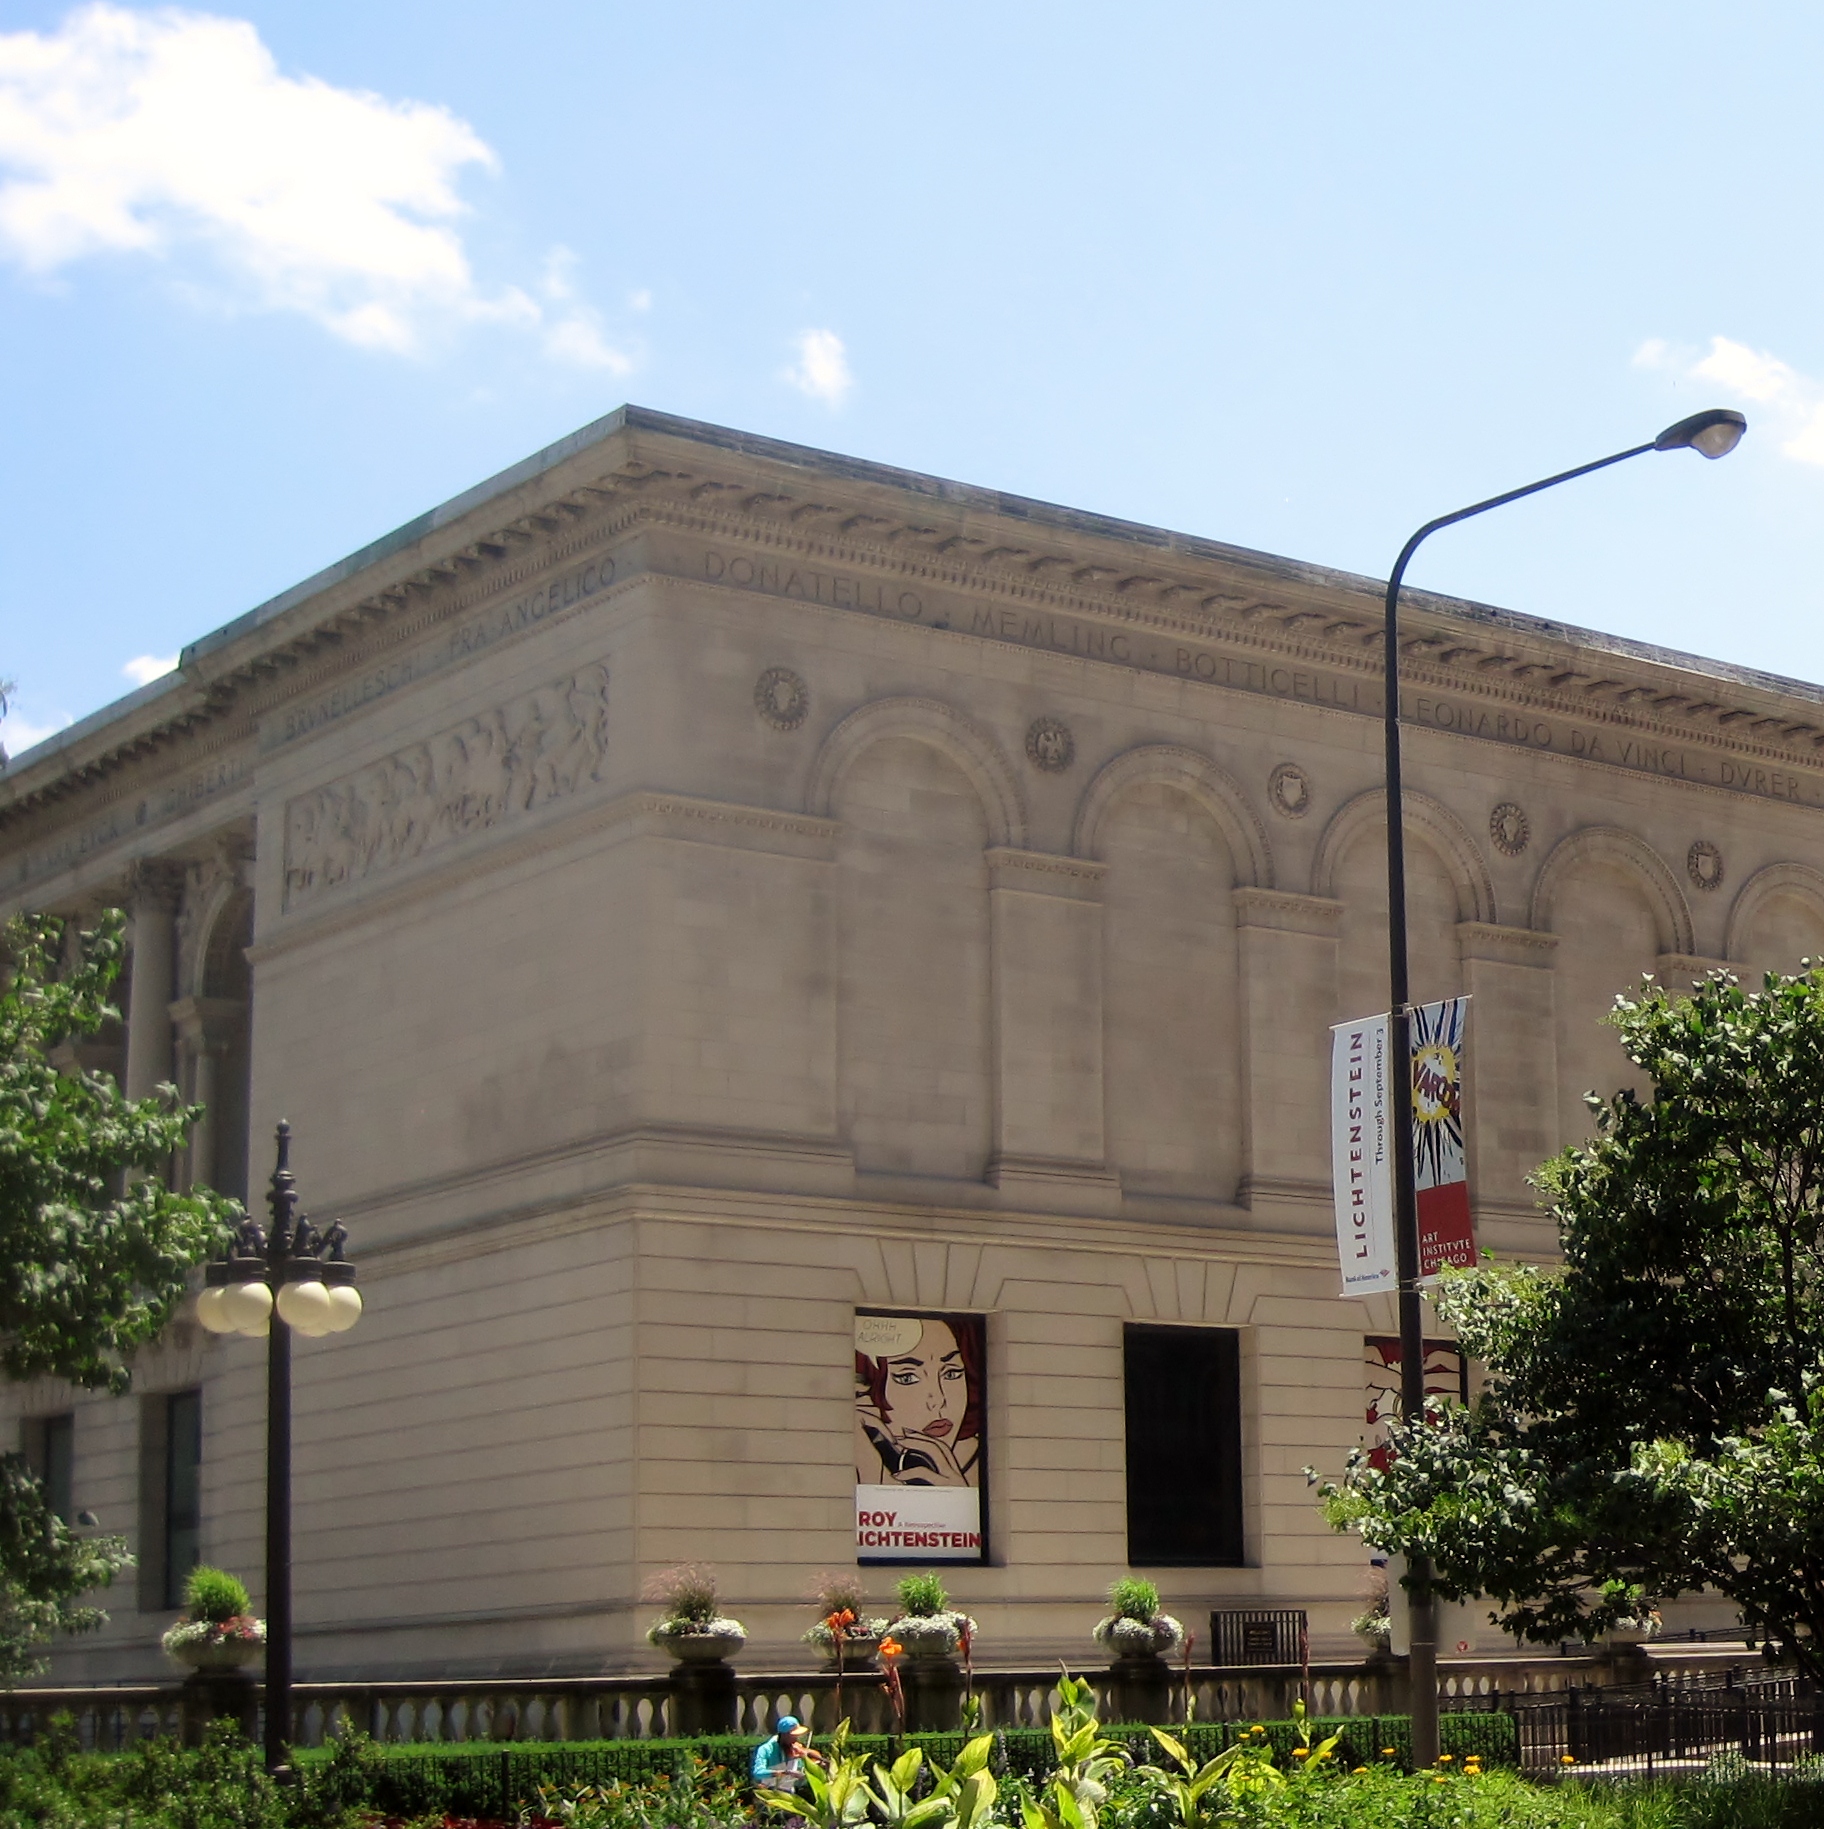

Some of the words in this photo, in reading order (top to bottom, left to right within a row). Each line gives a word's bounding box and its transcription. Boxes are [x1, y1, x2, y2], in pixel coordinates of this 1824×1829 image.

[449, 622, 488, 660] FRA
[500, 556, 617, 636] ANGELICO
[704, 549, 924, 621] DONATELLO
[970, 604, 1131, 662] MEMLING
[1175, 646, 1361, 708] BOTTICELLI
[1399, 695, 1553, 748] LEONARDO
[1570, 730, 1601, 757] DA
[1616, 740, 1686, 776] VINCI
[1720, 761, 1800, 801] DVRER
[1374, 1038, 1384, 1107] September
[1348, 1031, 1369, 1260] LICHTENSTEIN
[1374, 1110, 1384, 1166] Through
[1421, 1230, 1439, 1244] ART
[1423, 1238, 1471, 1257] INSTITVTE
[856, 1530, 983, 1548] ICHTENSTEIN
[858, 1510, 898, 1527] ROY
